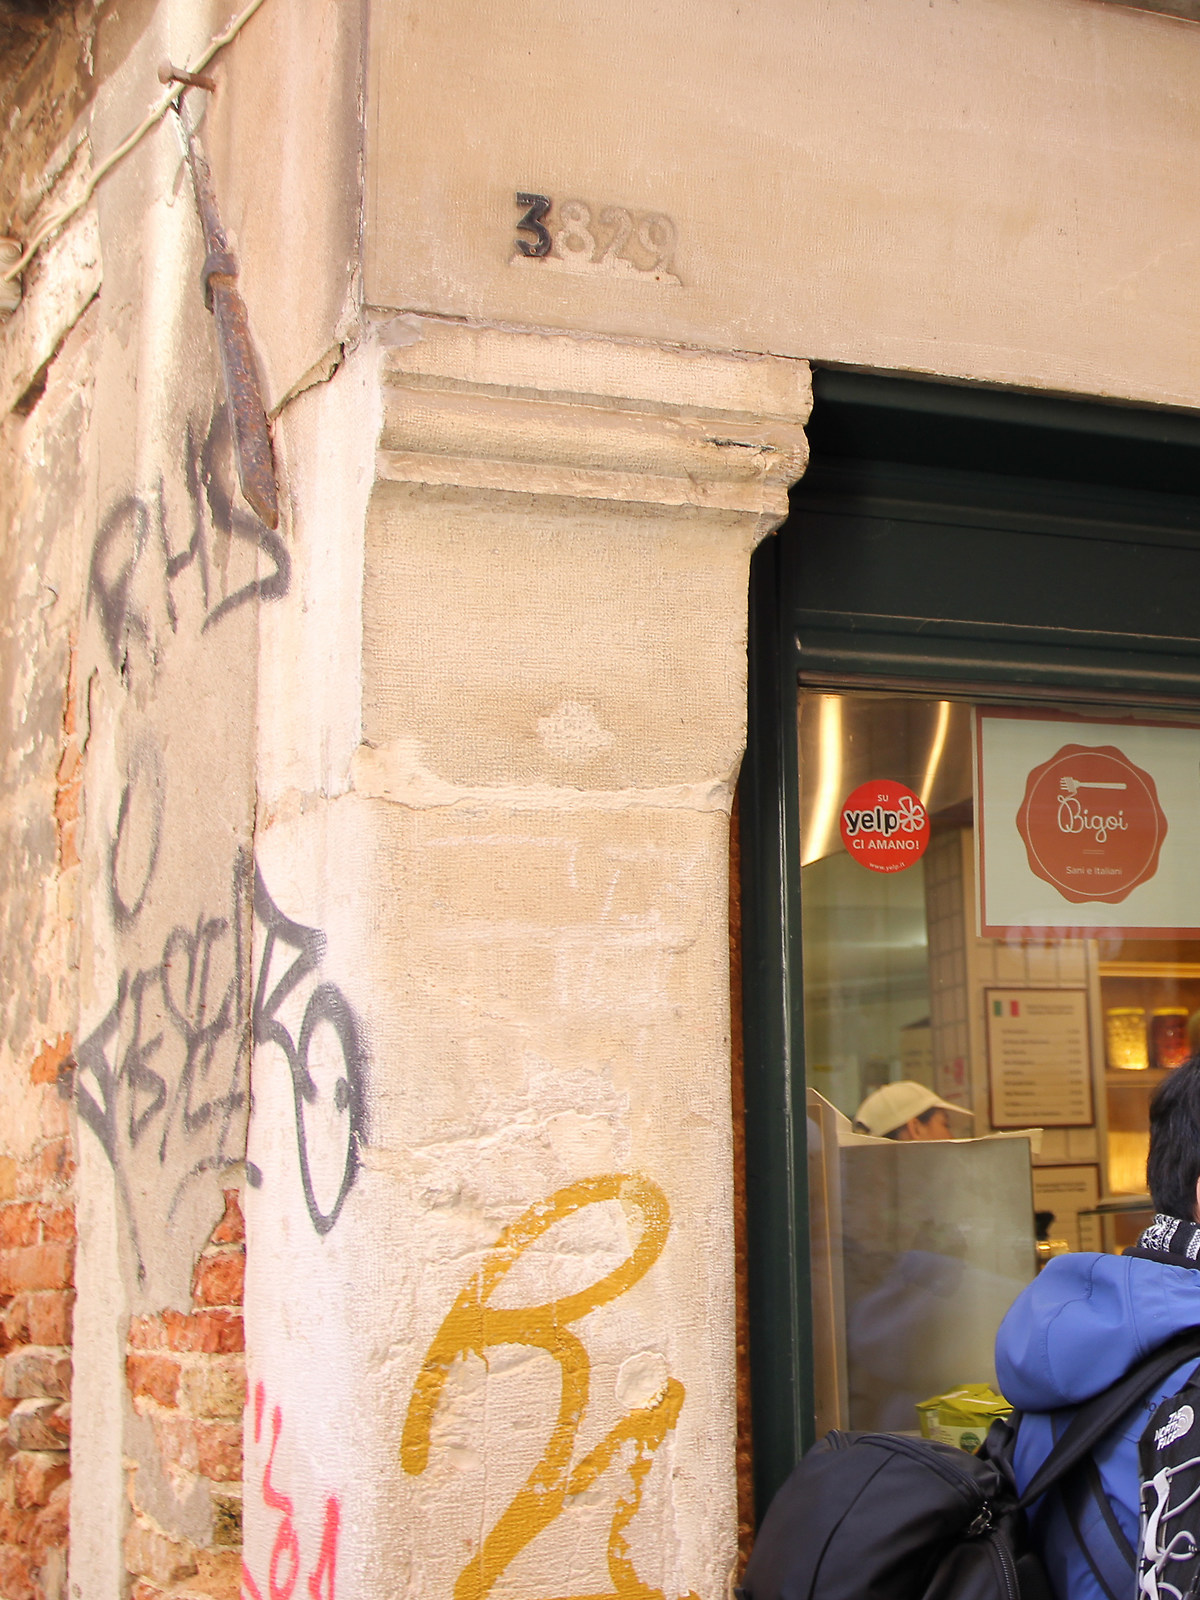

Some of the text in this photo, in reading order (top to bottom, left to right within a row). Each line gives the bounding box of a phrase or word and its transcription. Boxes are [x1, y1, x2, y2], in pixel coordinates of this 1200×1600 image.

[512, 192, 680, 284] 3829
[877, 794, 889, 802] SU
[844, 806, 899, 836] yelp
[1057, 795, 1128, 843] Bigoi
[852, 839, 919, 850] CI AMANO!
[869, 862, 905, 871] www.yelp.it
[1066, 866, 1123, 875] Sani e Italiani
[1167, 1409, 1183, 1424] THE
